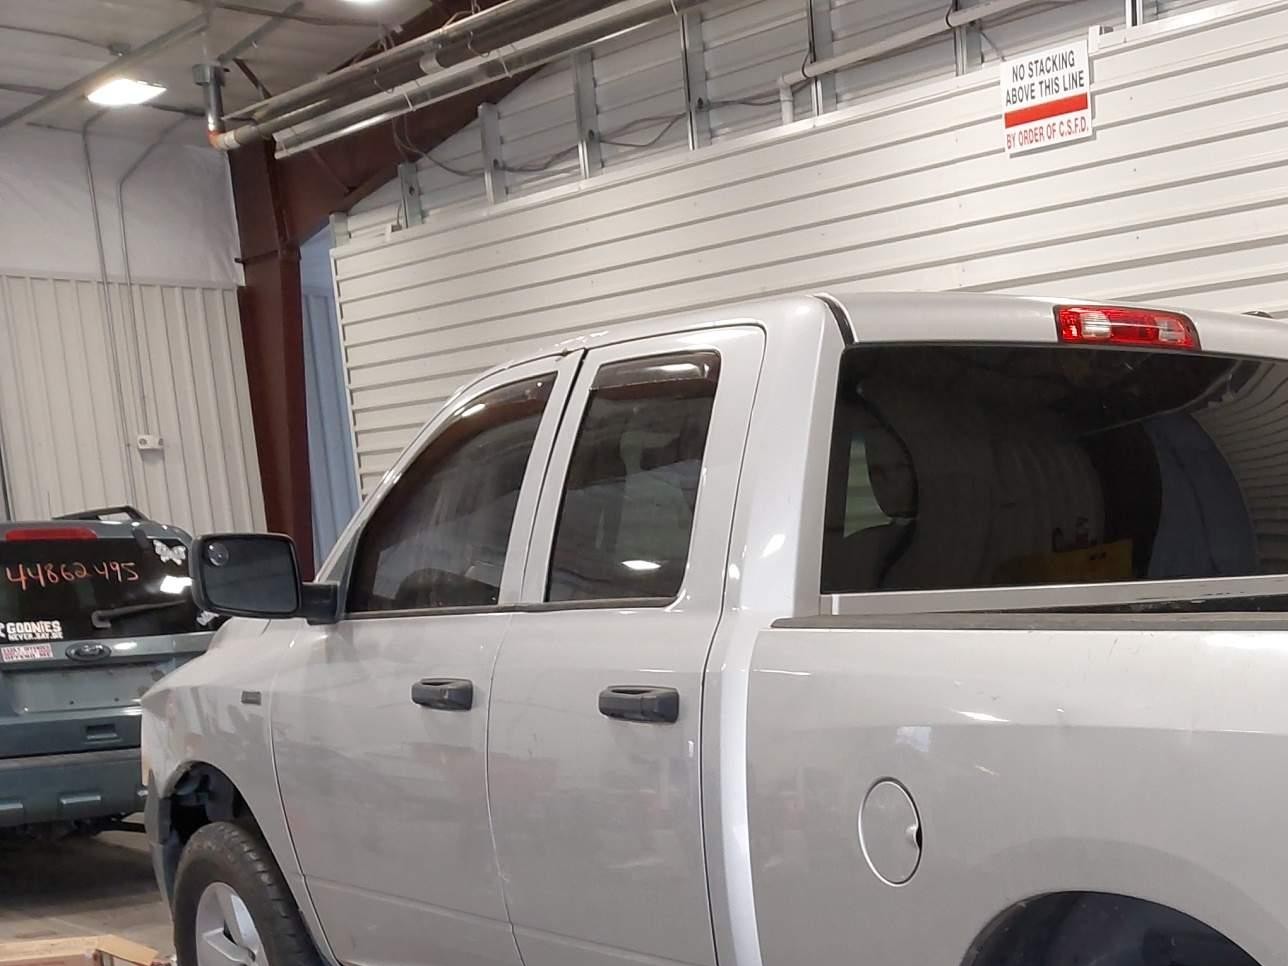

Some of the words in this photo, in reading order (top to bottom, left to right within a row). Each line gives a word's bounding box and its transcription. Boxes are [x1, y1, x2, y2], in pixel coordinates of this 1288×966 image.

[1012, 64, 1025, 83] NO
[1028, 50, 1075, 79] STACKING
[1005, 83, 1036, 106] ABOVE
[1039, 77, 1060, 97] THIS
[1063, 70, 1085, 92] LINE
[1006, 134, 1016, 150] BY
[1018, 126, 1044, 146] ORDER
[1046, 122, 1057, 139] OF
[1059, 116, 1089, 137] C.S.F.D.
[6, 620, 62, 634] GOONIES
